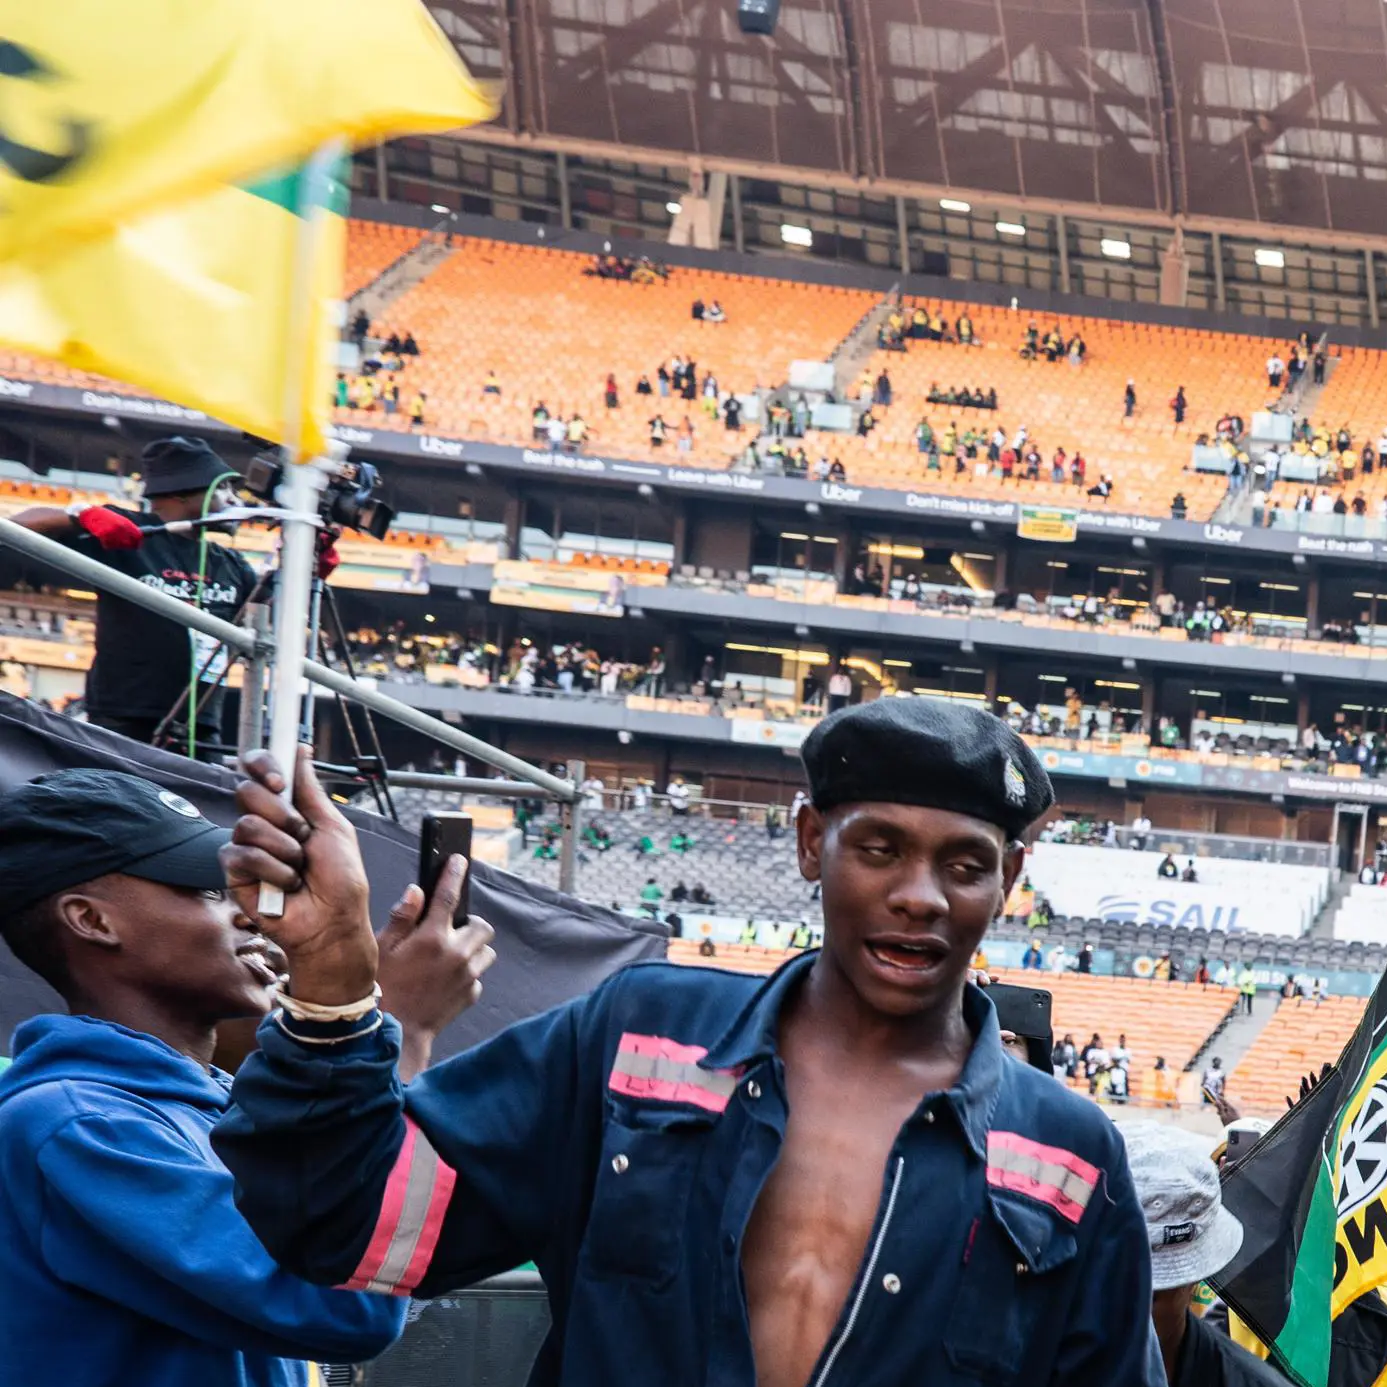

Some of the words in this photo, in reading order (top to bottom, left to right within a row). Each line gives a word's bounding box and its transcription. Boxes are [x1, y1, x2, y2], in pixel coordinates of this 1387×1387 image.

[0, 377, 33, 397] ber
[420, 435, 463, 456] Uber
[522, 449, 553, 464] Beat
[553, 453, 575, 468] the
[667, 467, 705, 484] Leave
[706, 473, 732, 487] with
[732, 475, 764, 490] Uber
[821, 482, 862, 501] Uber
[905, 492, 939, 509] Don't
[940, 497, 967, 512] miss
[1105, 514, 1131, 529] with
[1132, 516, 1161, 532] Uber
[1204, 523, 1243, 543] Uber
[1298, 536, 1326, 550] Beat
[1326, 539, 1346, 552] the
[1288, 776, 1338, 793] Welcome
[1338, 781, 1351, 794] to
[1351, 781, 1373, 796] FNB
[1148, 900, 1249, 932] SAIL
